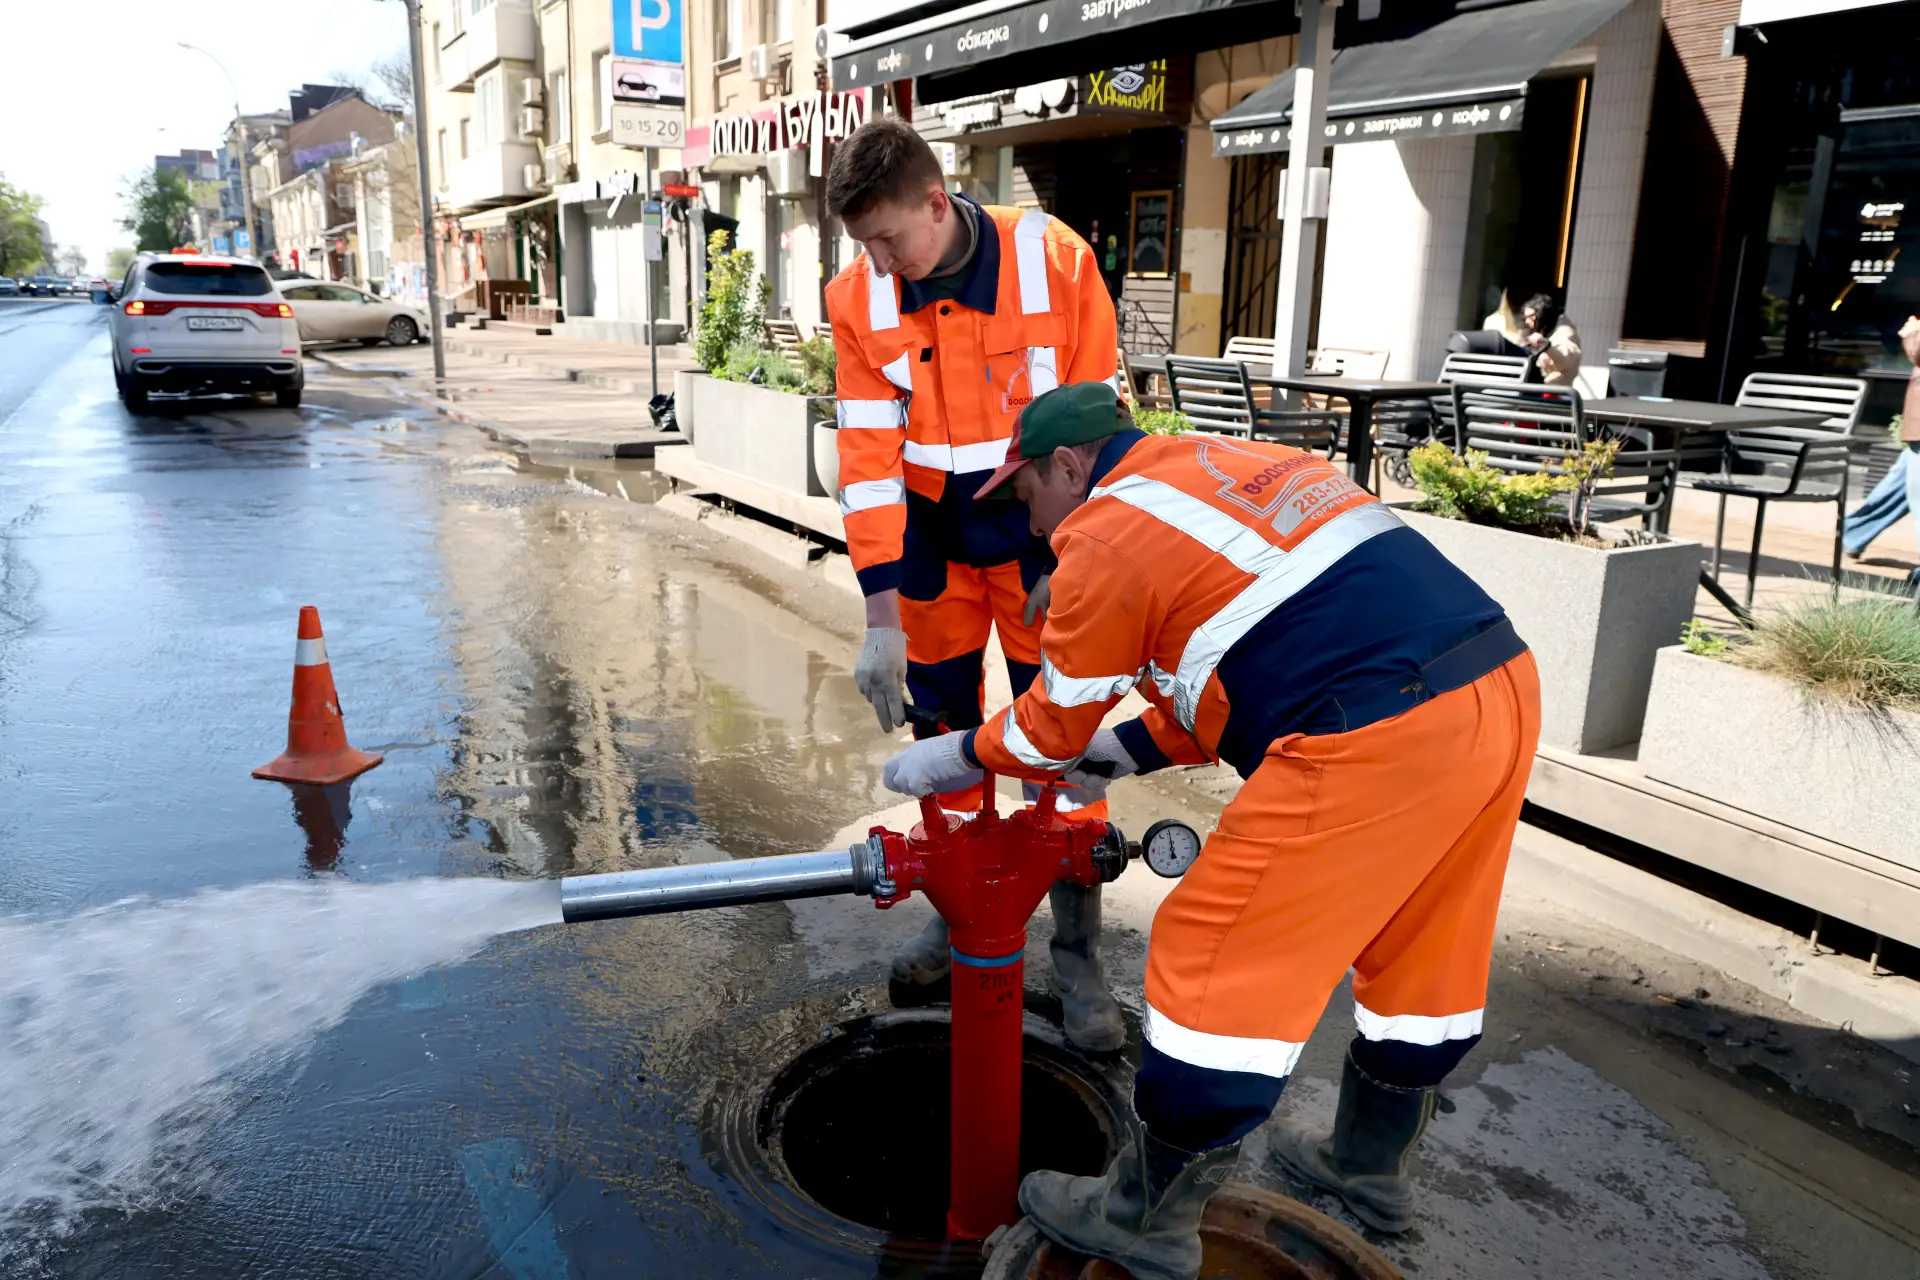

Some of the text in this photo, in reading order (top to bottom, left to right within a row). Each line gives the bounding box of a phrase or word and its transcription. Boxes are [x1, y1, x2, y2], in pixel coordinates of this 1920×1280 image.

[630, 0, 671, 52] P
[877, 48, 901, 72] кофе
[957, 24, 1010, 52] обжарка
[620, 119, 678, 136] 10 15 20
[709, 115, 754, 156] 1000
[1235, 104, 1491, 147] кофе завтраки кофе
